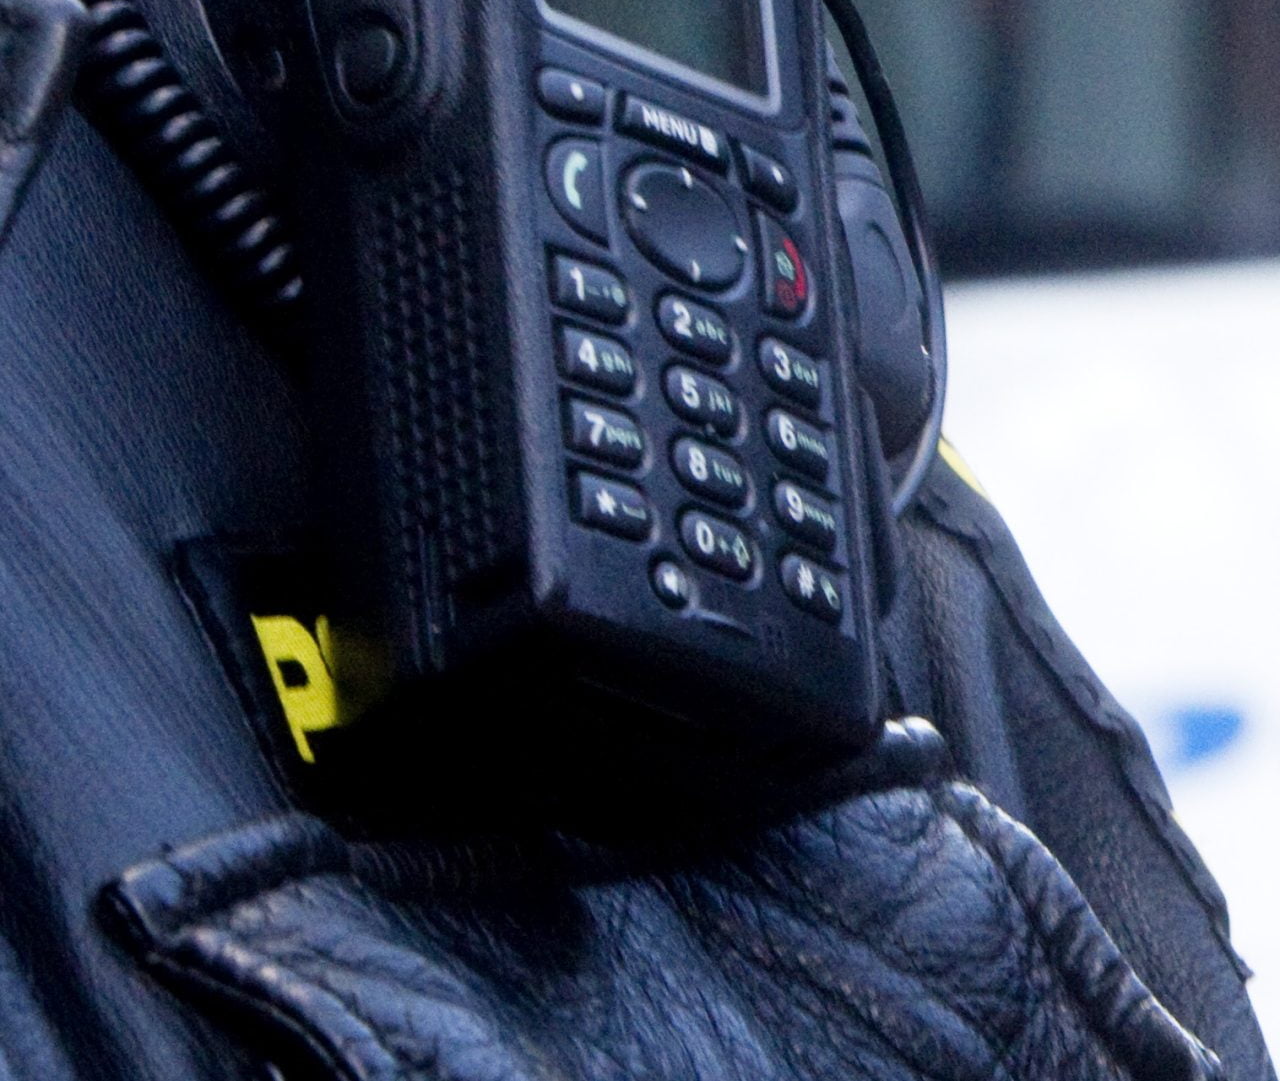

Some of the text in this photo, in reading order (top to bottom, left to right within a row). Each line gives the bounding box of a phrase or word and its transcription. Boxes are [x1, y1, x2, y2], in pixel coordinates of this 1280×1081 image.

[641, 105, 698, 145] MENU
[569, 266, 586, 302] 1
[672, 300, 694, 339] 2
[577, 337, 600, 373] 4
[772, 345, 792, 382] 3
[680, 372, 701, 409] 5
[583, 410, 606, 447] 7
[777, 414, 798, 451] 6
[687, 445, 709, 483] 8
[785, 486, 805, 524] 9
[695, 519, 716, 555] 0
[249, 612, 340, 764] P
